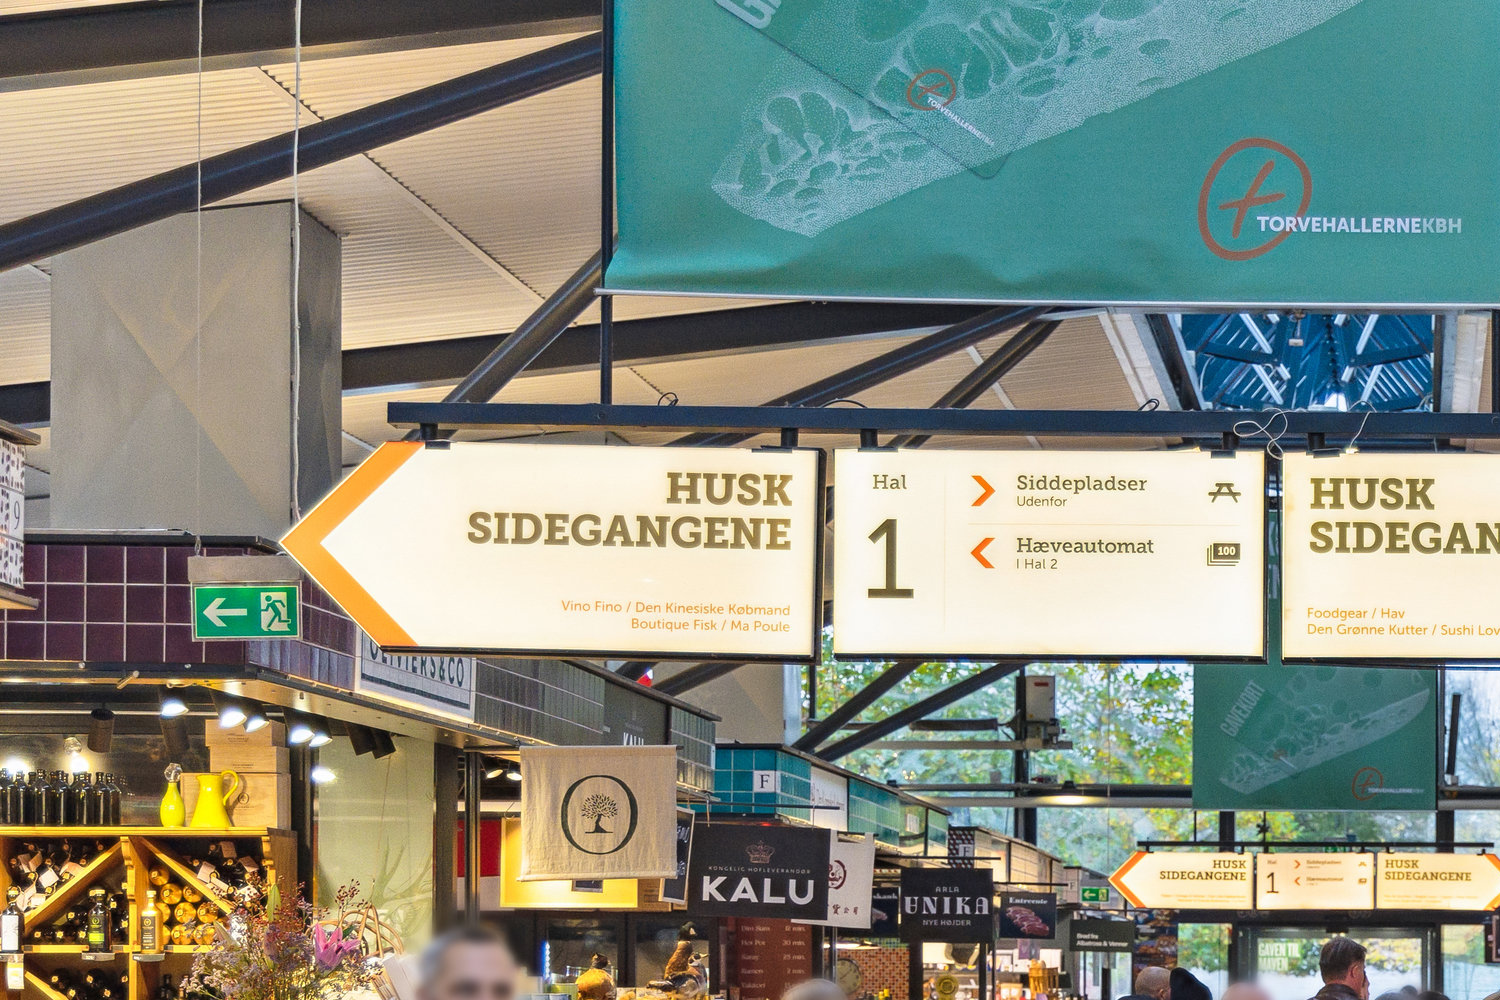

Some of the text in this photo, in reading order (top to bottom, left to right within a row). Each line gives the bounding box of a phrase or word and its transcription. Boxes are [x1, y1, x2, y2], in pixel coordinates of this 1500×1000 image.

[1256, 216, 1462, 234] TORVEHALLERNEKBH
[667, 472, 793, 507] HUSK
[872, 474, 908, 490] Hal
[1016, 475, 1148, 494] Siddepladser
[1016, 496, 1068, 507] Udenfor
[1310, 477, 1435, 511] HUSK
[467, 511, 791, 550] SIDEGANGENE
[1016, 537, 1154, 554] Hæveautomat
[1217, 546, 1236, 556] 100
[867, 518, 915, 599] 1
[1024, 558, 1047, 570] Hal
[1050, 558, 1058, 570] 2
[561, 600, 590, 611] Vino
[594, 600, 623, 612] Fino
[635, 602, 662, 614] Den
[665, 602, 725, 615] Kinesiske
[728, 603, 791, 617] Købmand
[1307, 607, 1369, 622] Foodgear
[1380, 607, 1406, 620] Hav
[631, 617, 691, 633] Boutique
[693, 618, 718, 631] Fisk
[731, 619, 750, 632] Ma
[753, 620, 791, 633] Poule
[1307, 623, 1333, 636] Den
[1337, 623, 1385, 636] Grønne
[1388, 623, 1429, 636] Kutter
[1440, 624, 1475, 637] Sushi
[1220, 680, 1266, 737] GAVEKORT
[759, 773, 770, 789] F
[1212, 860, 1247, 870] HUSK
[1385, 859, 1419, 869] HUSK
[1159, 870, 1247, 881] SIDEGANGENE
[1266, 872, 1279, 894] 1
[1385, 871, 1472, 882] SIDEGANGENE
[702, 875, 815, 907] KALU
[904, 896, 989, 915] UNIKA
[1258, 942, 1286, 957] GAVEN
